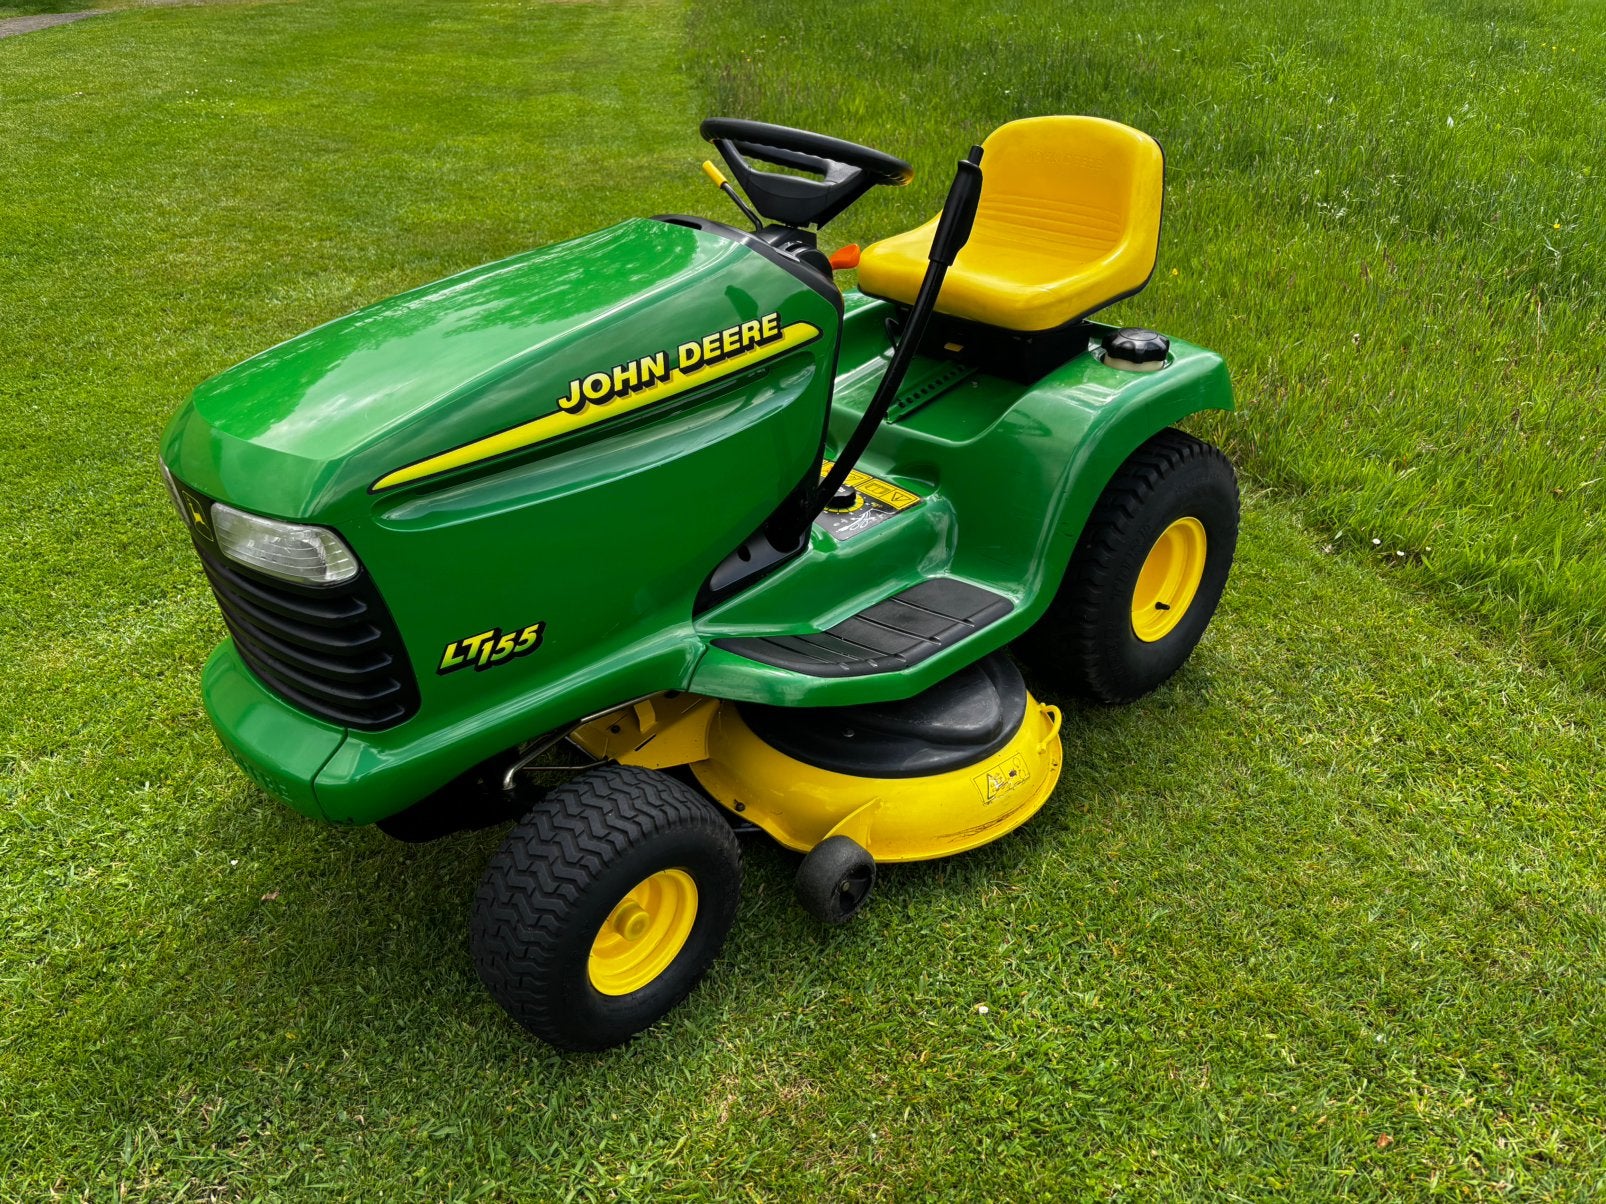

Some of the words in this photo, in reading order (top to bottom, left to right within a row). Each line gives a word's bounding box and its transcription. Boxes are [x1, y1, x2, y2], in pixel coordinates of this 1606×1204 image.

[557, 351, 668, 413] JOHN
[676, 312, 782, 373] DEERE
[437, 621, 543, 674] LT155
